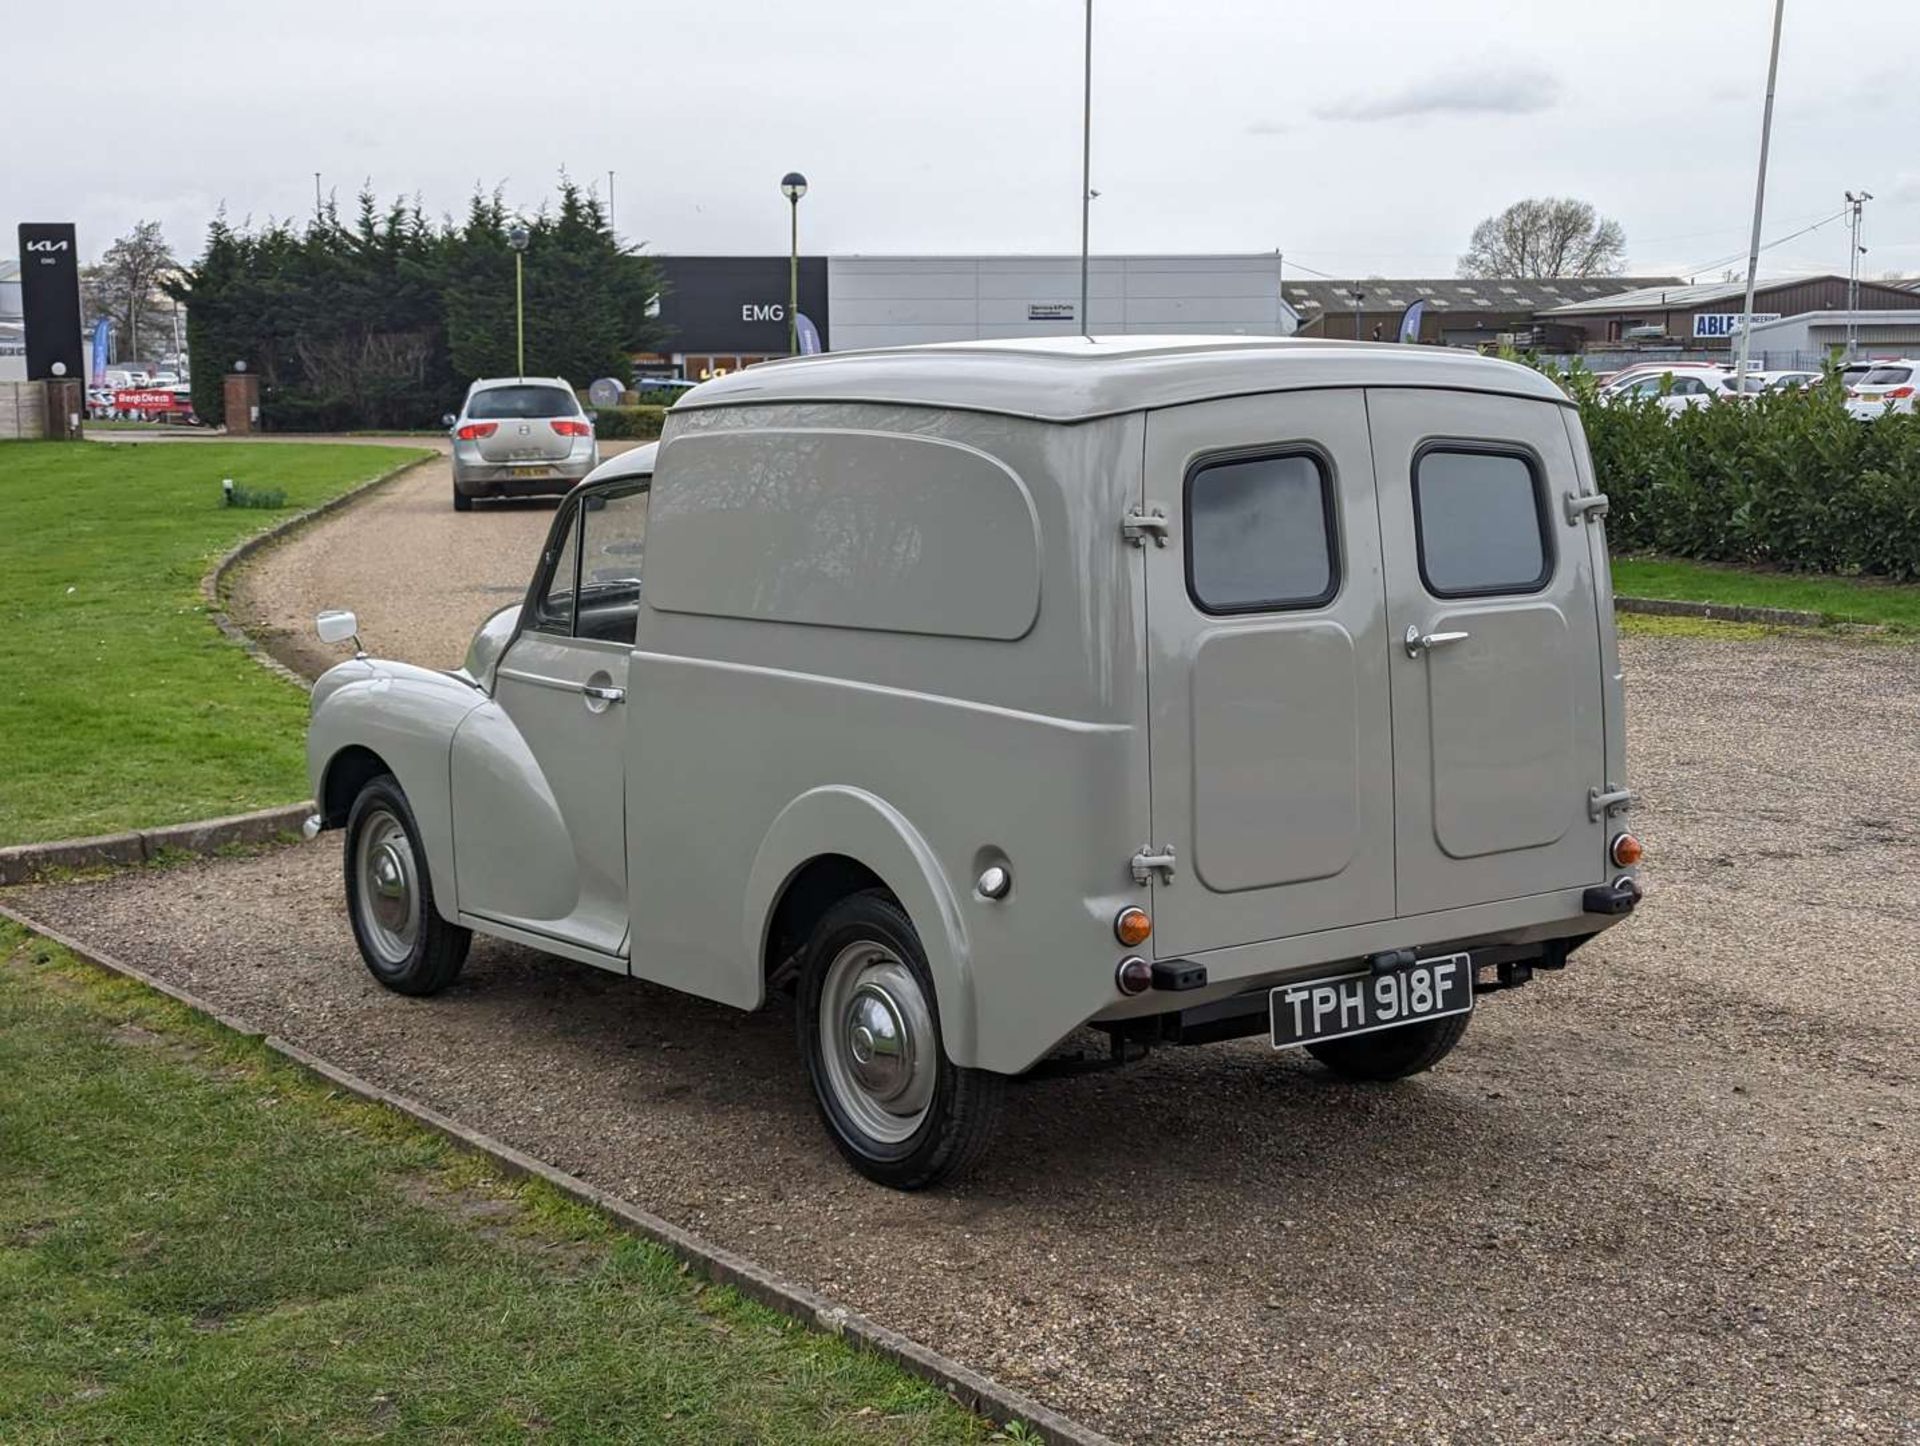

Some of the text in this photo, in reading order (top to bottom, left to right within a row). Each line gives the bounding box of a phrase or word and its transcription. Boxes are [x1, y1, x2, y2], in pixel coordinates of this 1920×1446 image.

[742, 305, 784, 321] EMG
[1285, 963, 1456, 1037] TPH 918F
